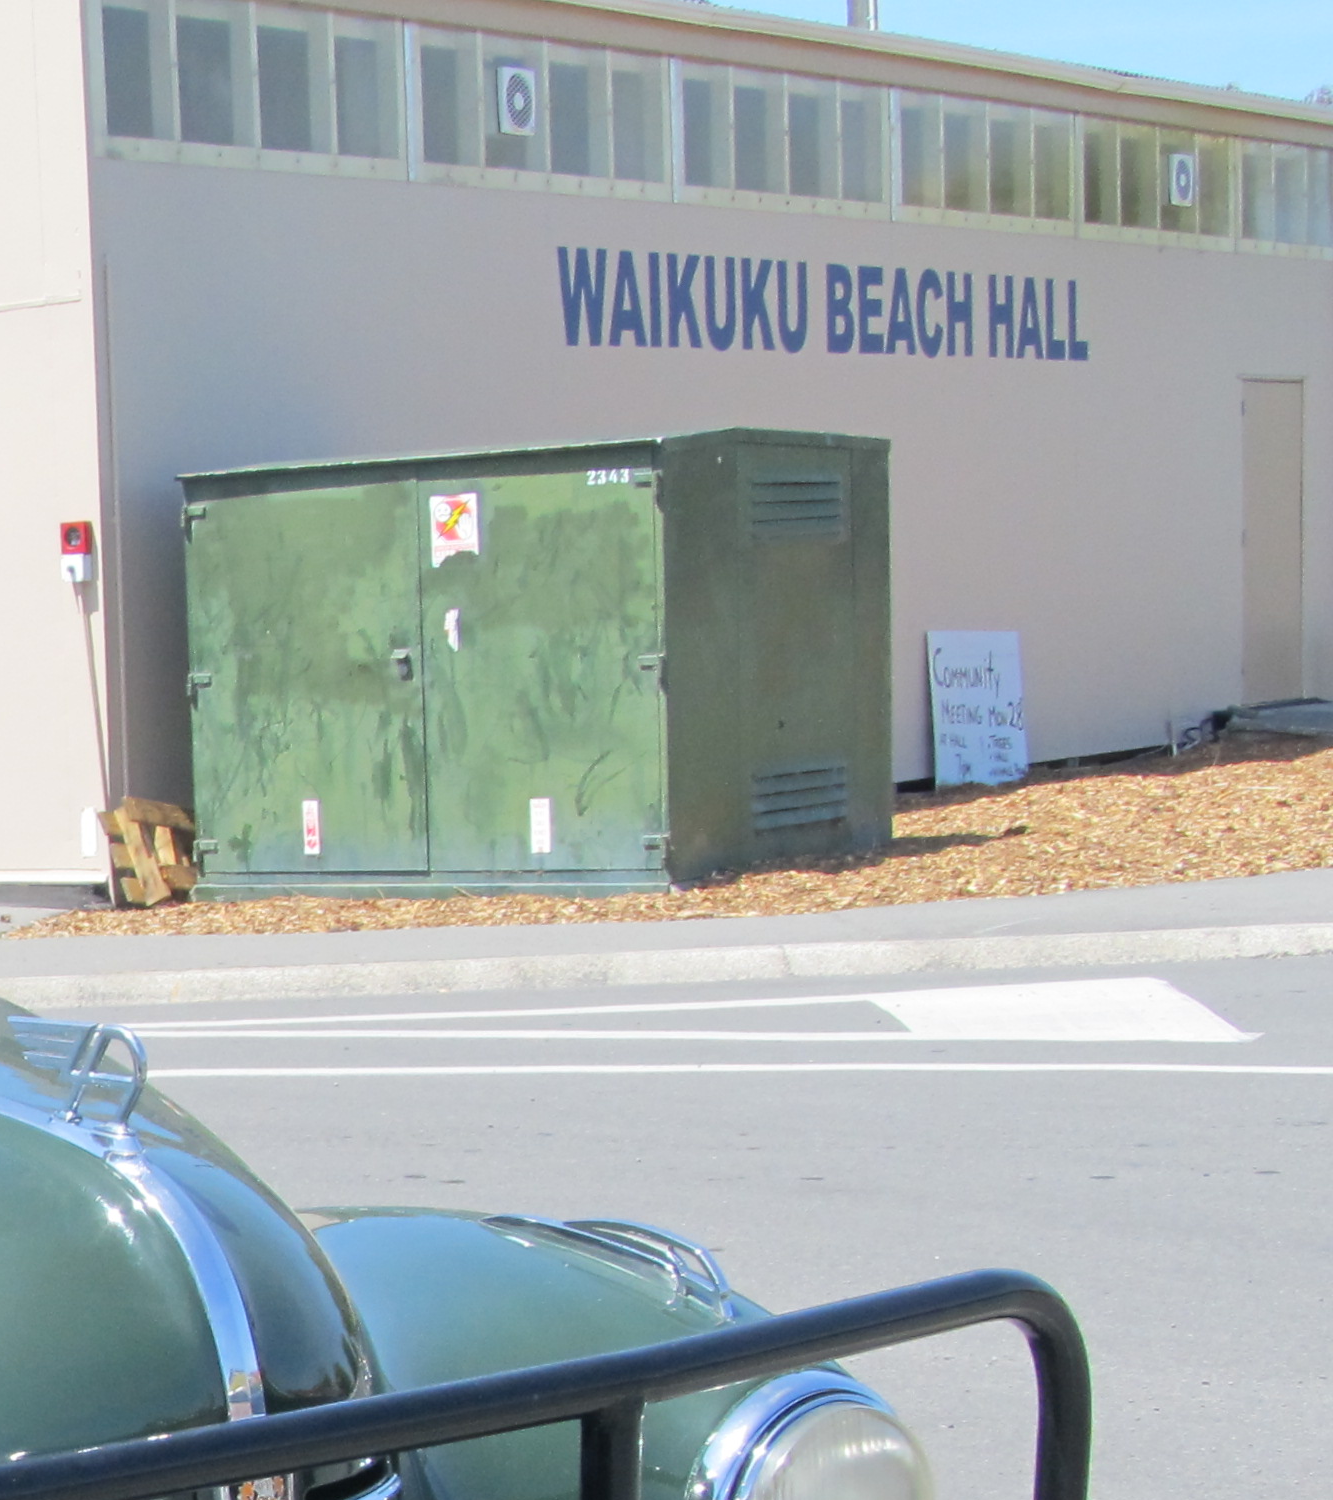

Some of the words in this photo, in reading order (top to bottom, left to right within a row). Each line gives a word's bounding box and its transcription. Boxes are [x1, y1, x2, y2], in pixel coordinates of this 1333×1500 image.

[556, 246, 809, 353] WAIKUKU
[826, 262, 974, 358] BEACH
[988, 273, 1090, 361] HALL
[586, 468, 630, 486] 2343
